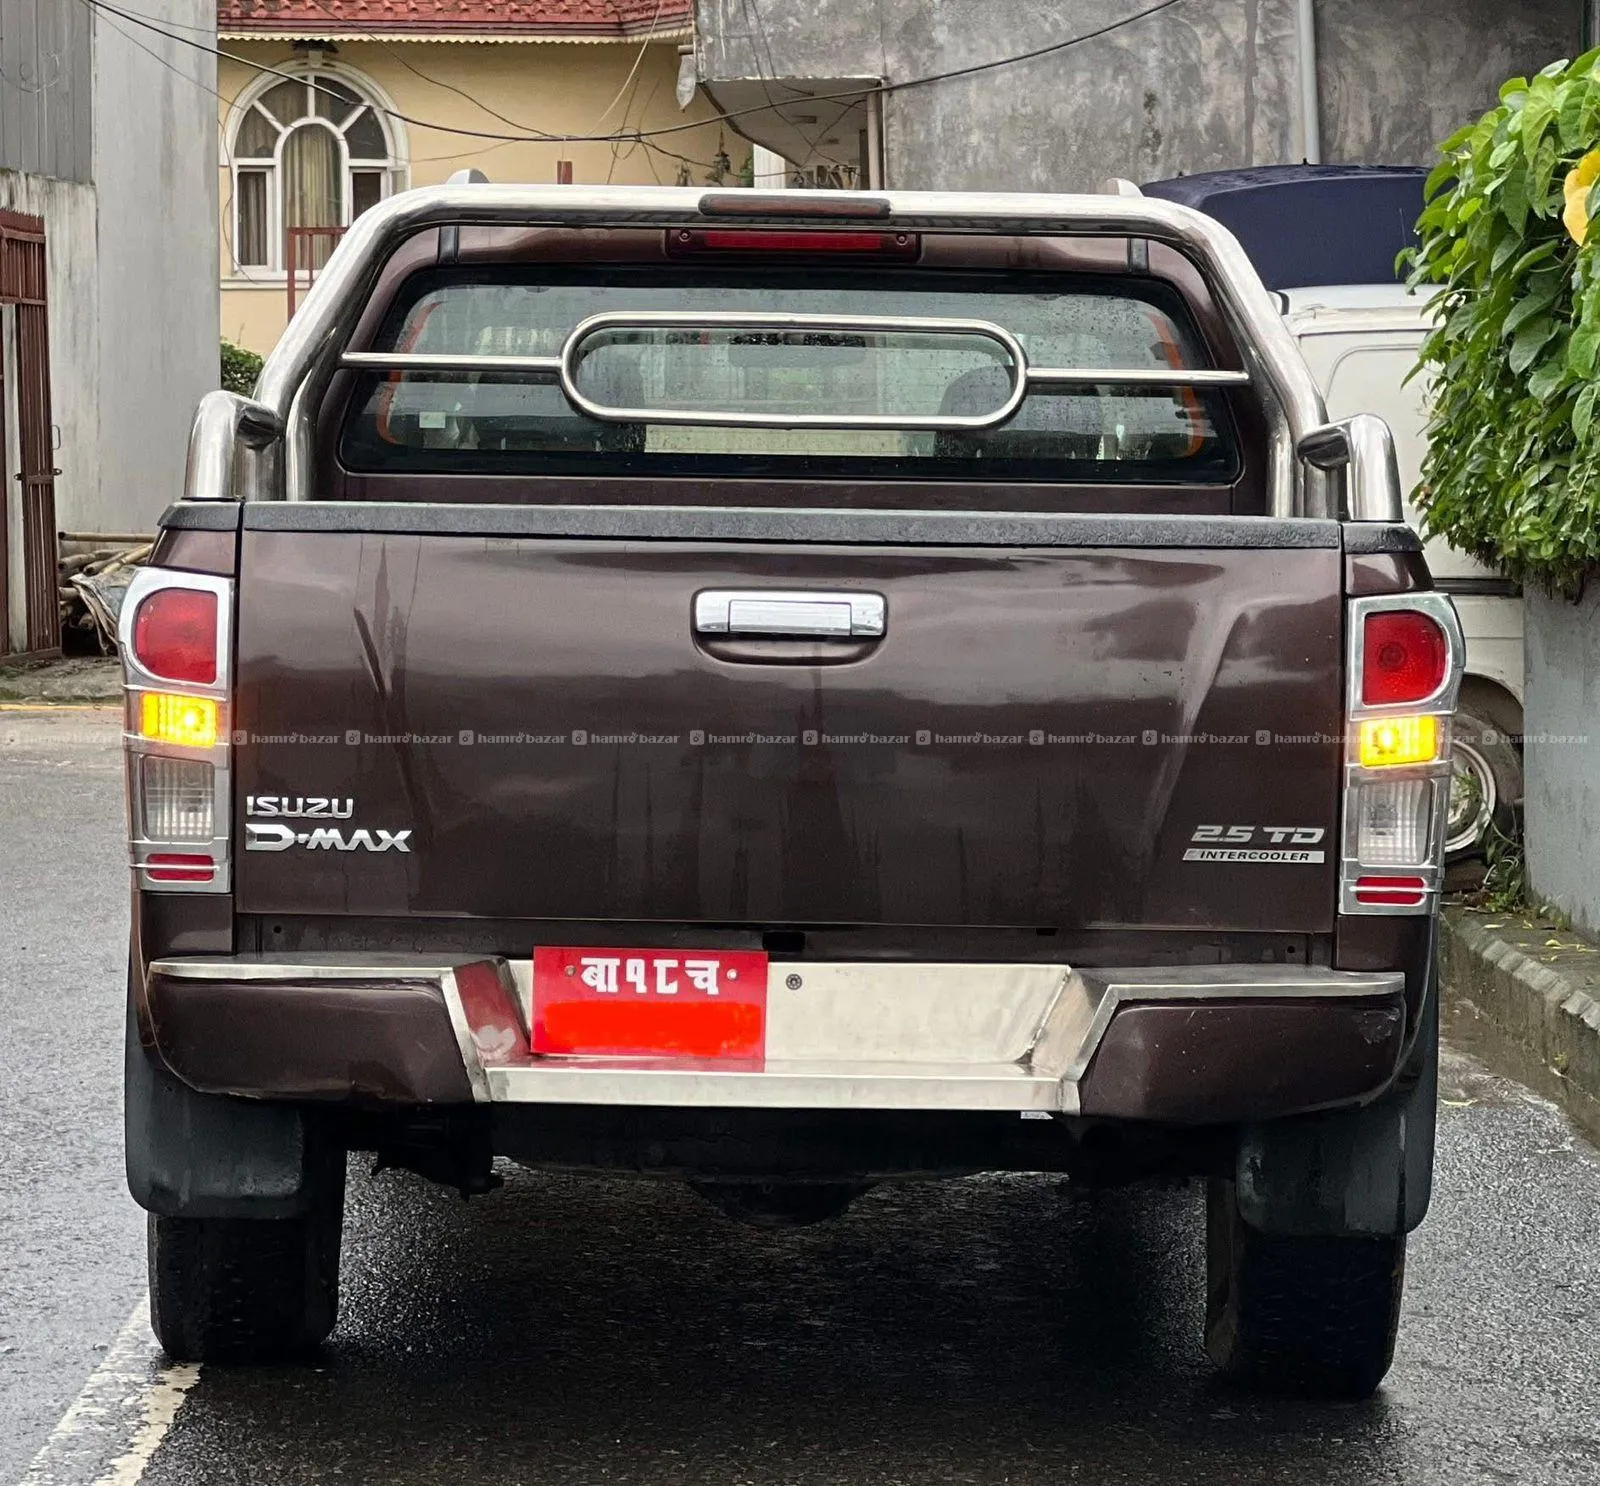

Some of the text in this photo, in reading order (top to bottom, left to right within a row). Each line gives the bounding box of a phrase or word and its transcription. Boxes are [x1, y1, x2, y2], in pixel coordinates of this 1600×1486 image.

[246, 796, 353, 819] ISUZU
[245, 823, 412, 852] D-MAX
[1263, 827, 1325, 844] TD
[1200, 850, 1310, 861] INTERCOOLER
